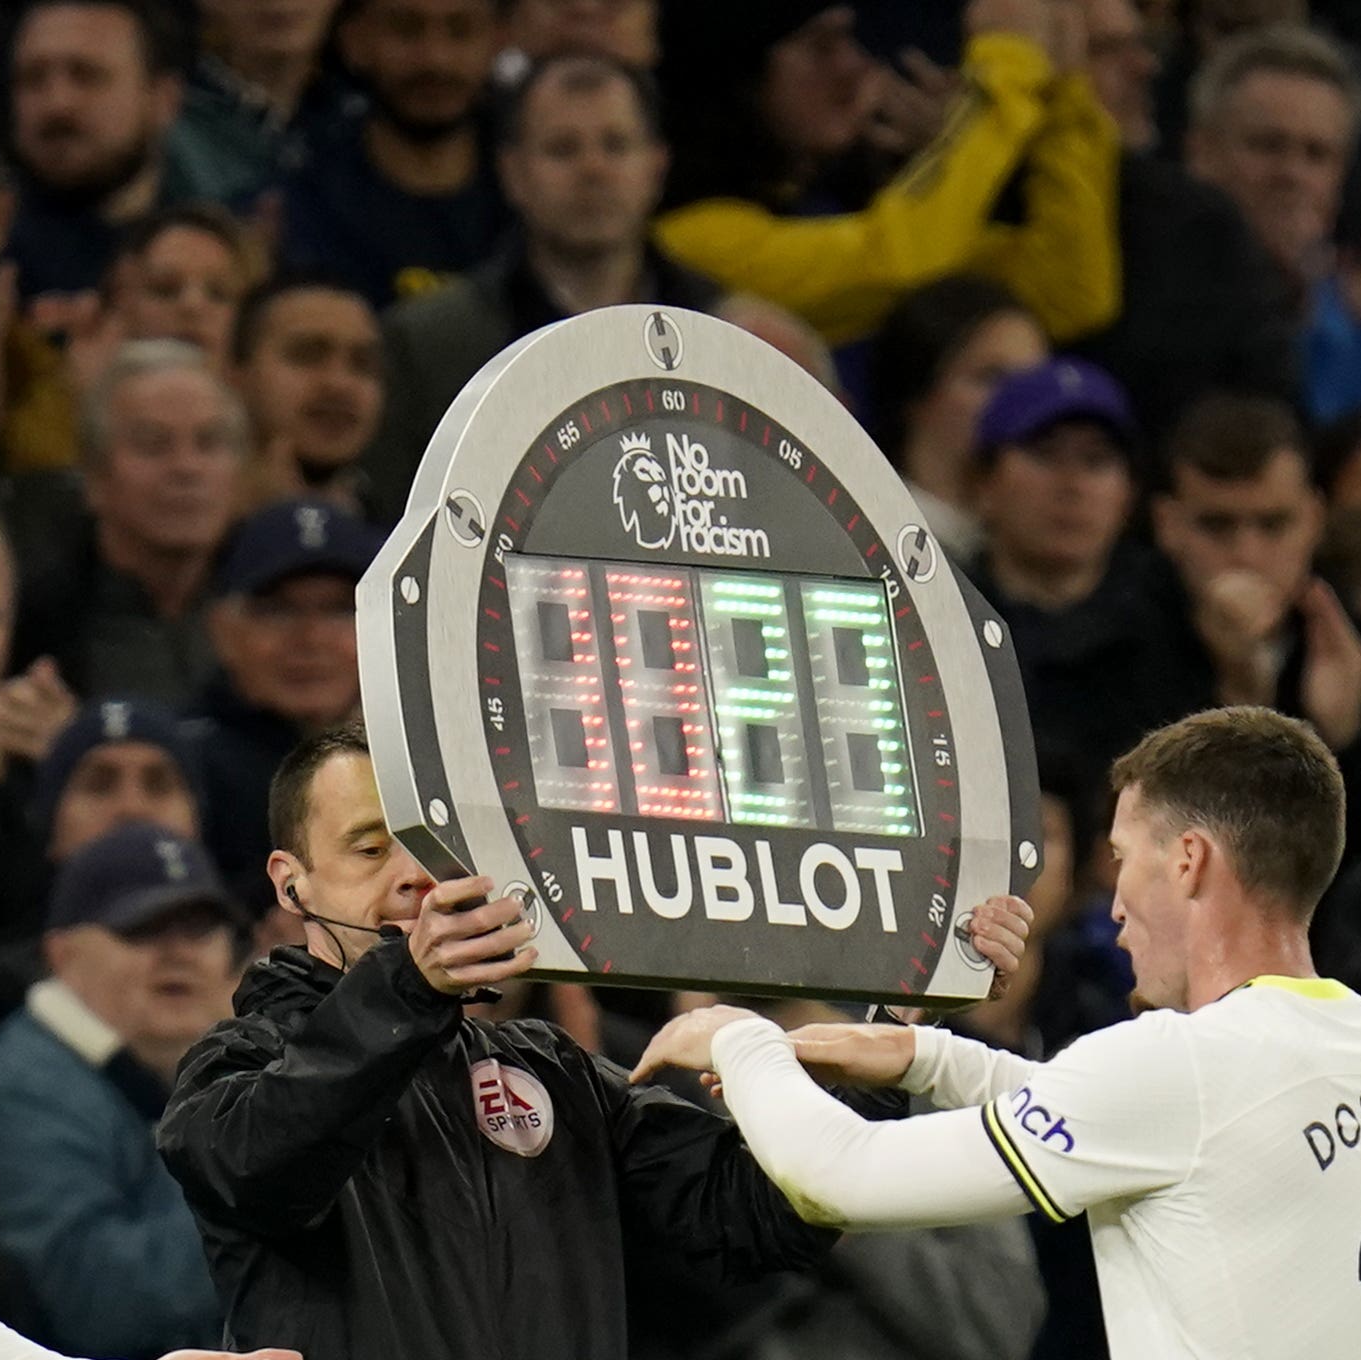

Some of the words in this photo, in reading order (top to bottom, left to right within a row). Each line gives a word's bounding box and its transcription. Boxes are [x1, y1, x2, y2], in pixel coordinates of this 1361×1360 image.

[662, 390, 685, 410] 60
[558, 421, 581, 450] 55
[666, 433, 709, 470] No
[779, 439, 802, 470] 05
[673, 465, 748, 499] room
[675, 490, 715, 529] for
[680, 515, 771, 558] racism
[488, 697, 504, 732] 45
[933, 734, 951, 768] 15
[541, 870, 563, 903] 40
[571, 826, 904, 933] HUBLOT
[928, 894, 947, 928] 20
[487, 1112, 541, 1132] SPRTS
[1009, 1086, 1075, 1153] nch
